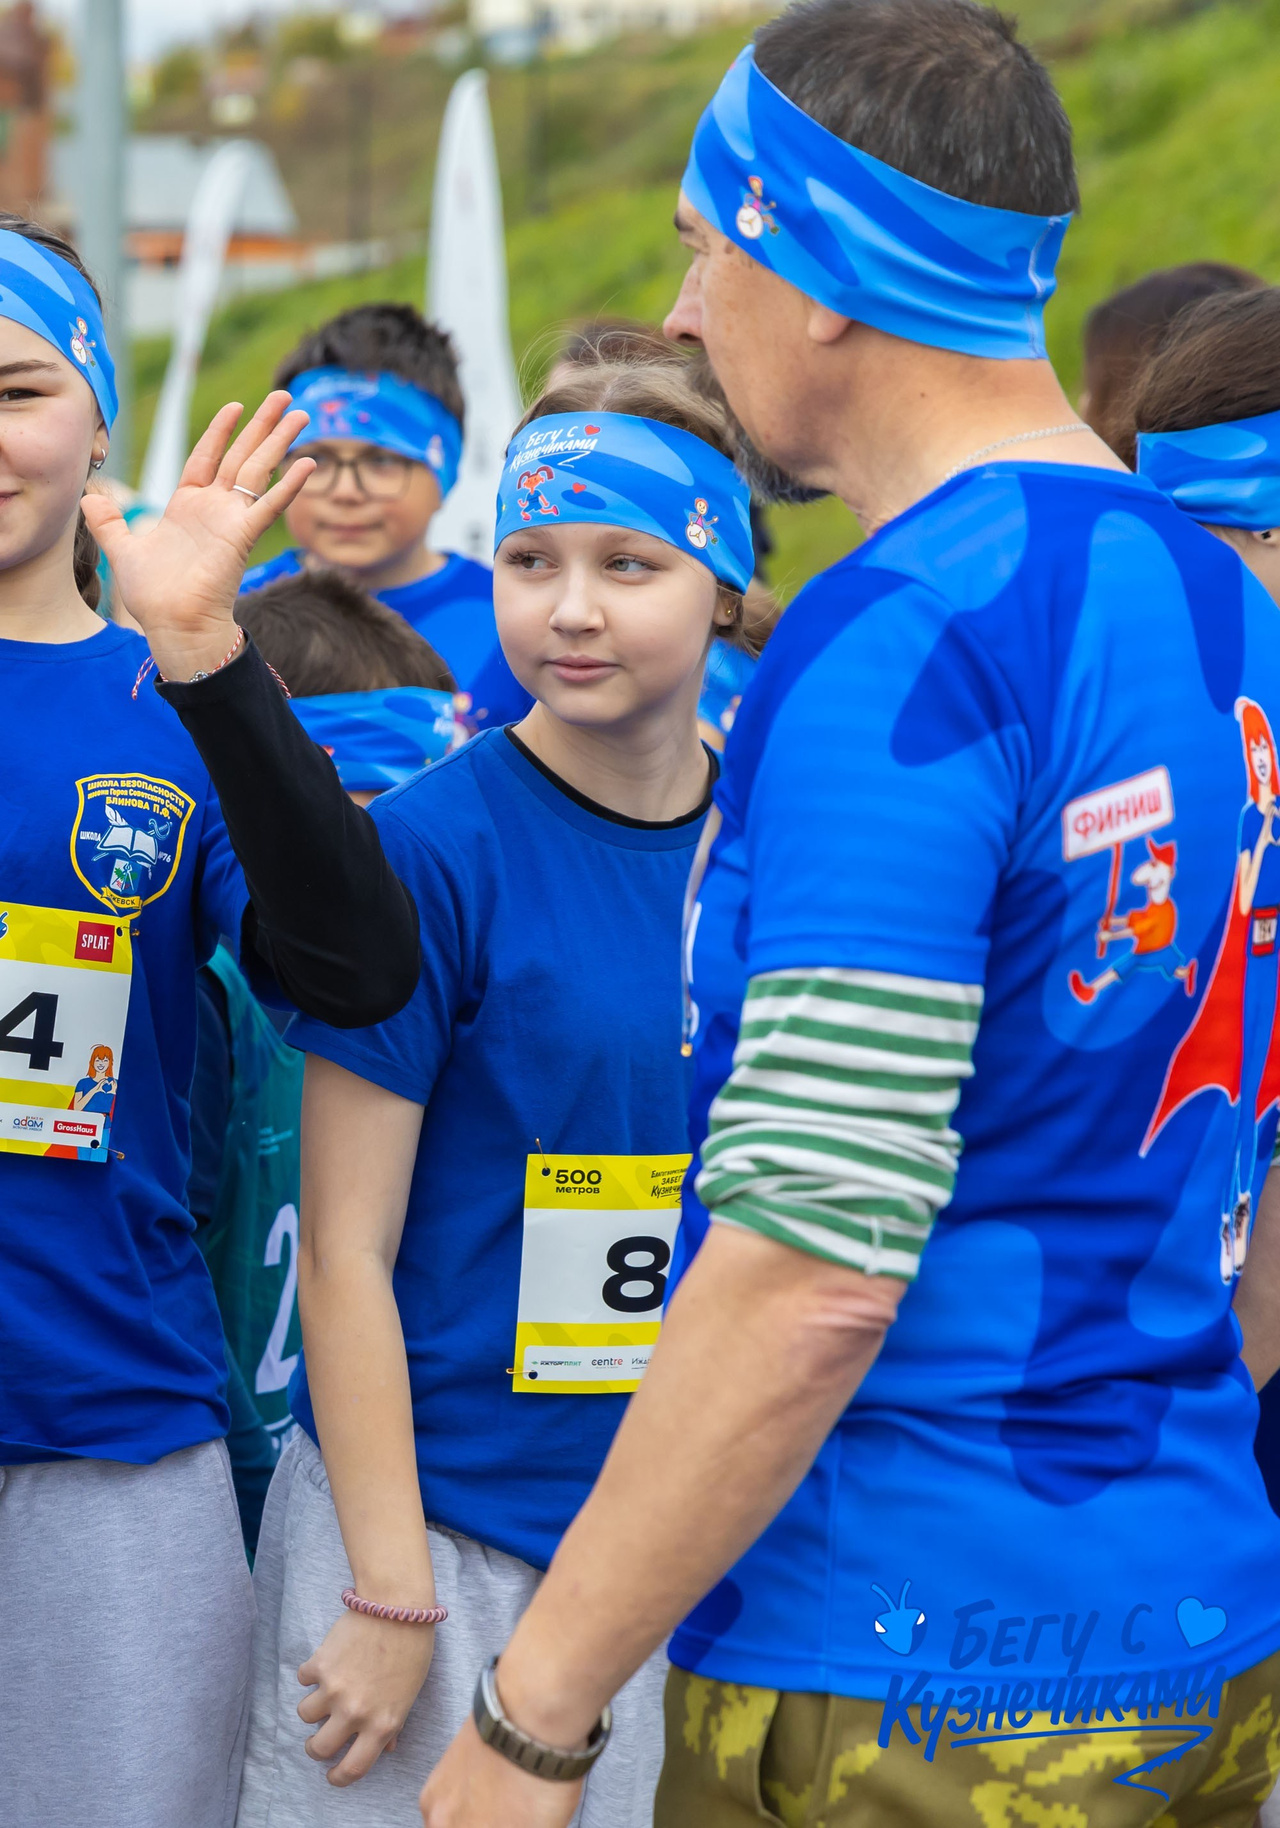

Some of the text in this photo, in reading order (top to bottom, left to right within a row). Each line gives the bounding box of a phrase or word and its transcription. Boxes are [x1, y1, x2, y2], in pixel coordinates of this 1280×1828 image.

[87, 780, 185, 809] ШКОЛА БЕЗОПАСНОСТИ
[128, 789, 165, 806] Советского
[105, 796, 150, 811] БЛИНОВА
[1073, 786, 1163, 840] ФИНИШ
[81, 934, 109, 951] SPLAT
[56, 1123, 94, 1134] GrossHaus
[555, 1169, 602, 1185] 500
[661, 1175, 682, 1185] ЗАБЕГ
[555, 1186, 600, 1195] метров
[591, 1357, 624, 1367] centre
